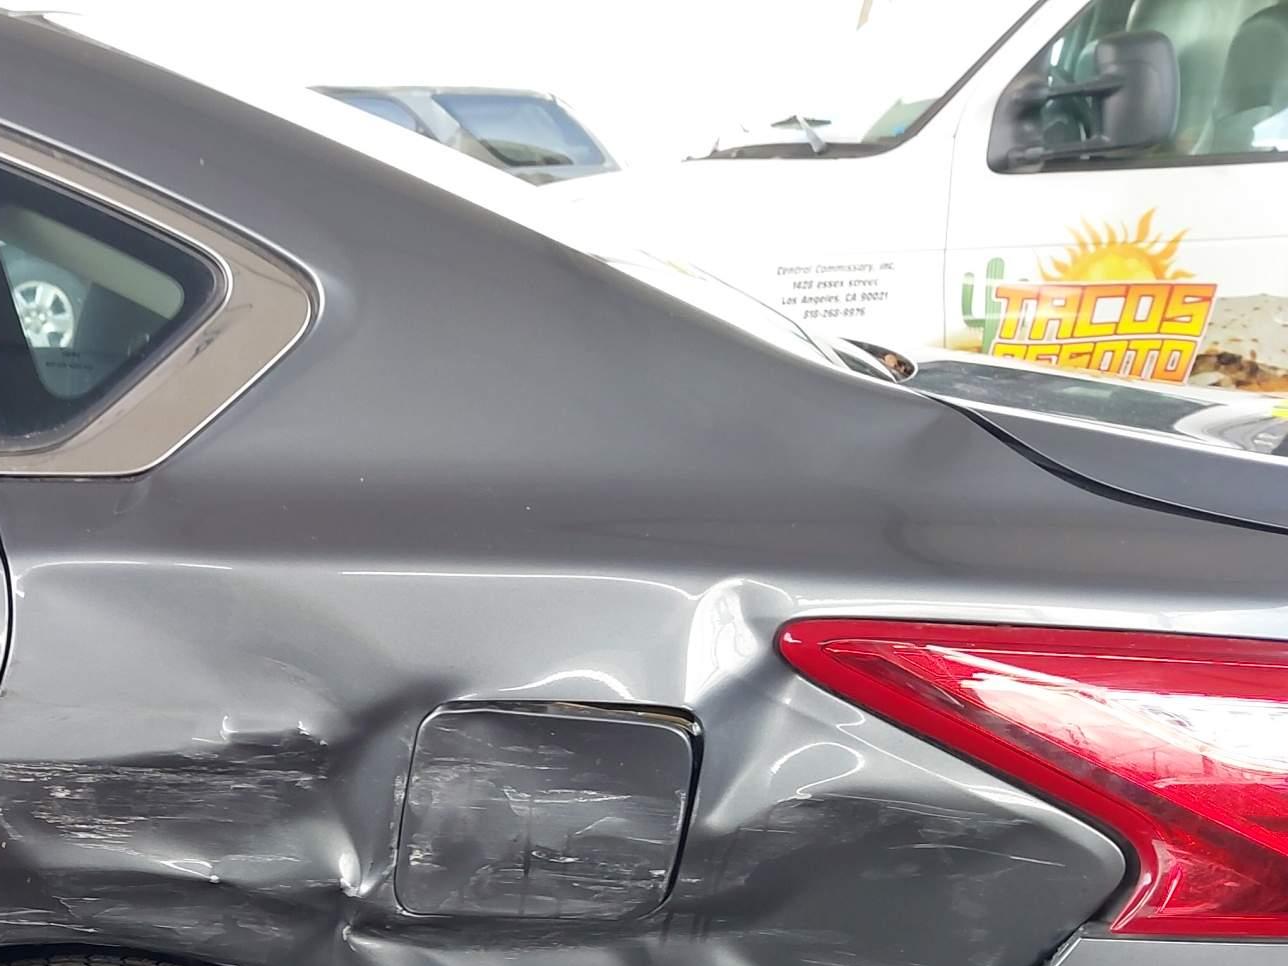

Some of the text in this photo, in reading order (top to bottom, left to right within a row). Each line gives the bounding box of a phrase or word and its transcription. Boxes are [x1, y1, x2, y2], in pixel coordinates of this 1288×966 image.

[781, 297, 798, 305] Los
[844, 293, 857, 302] CA
[995, 283, 1217, 341] TACOS
